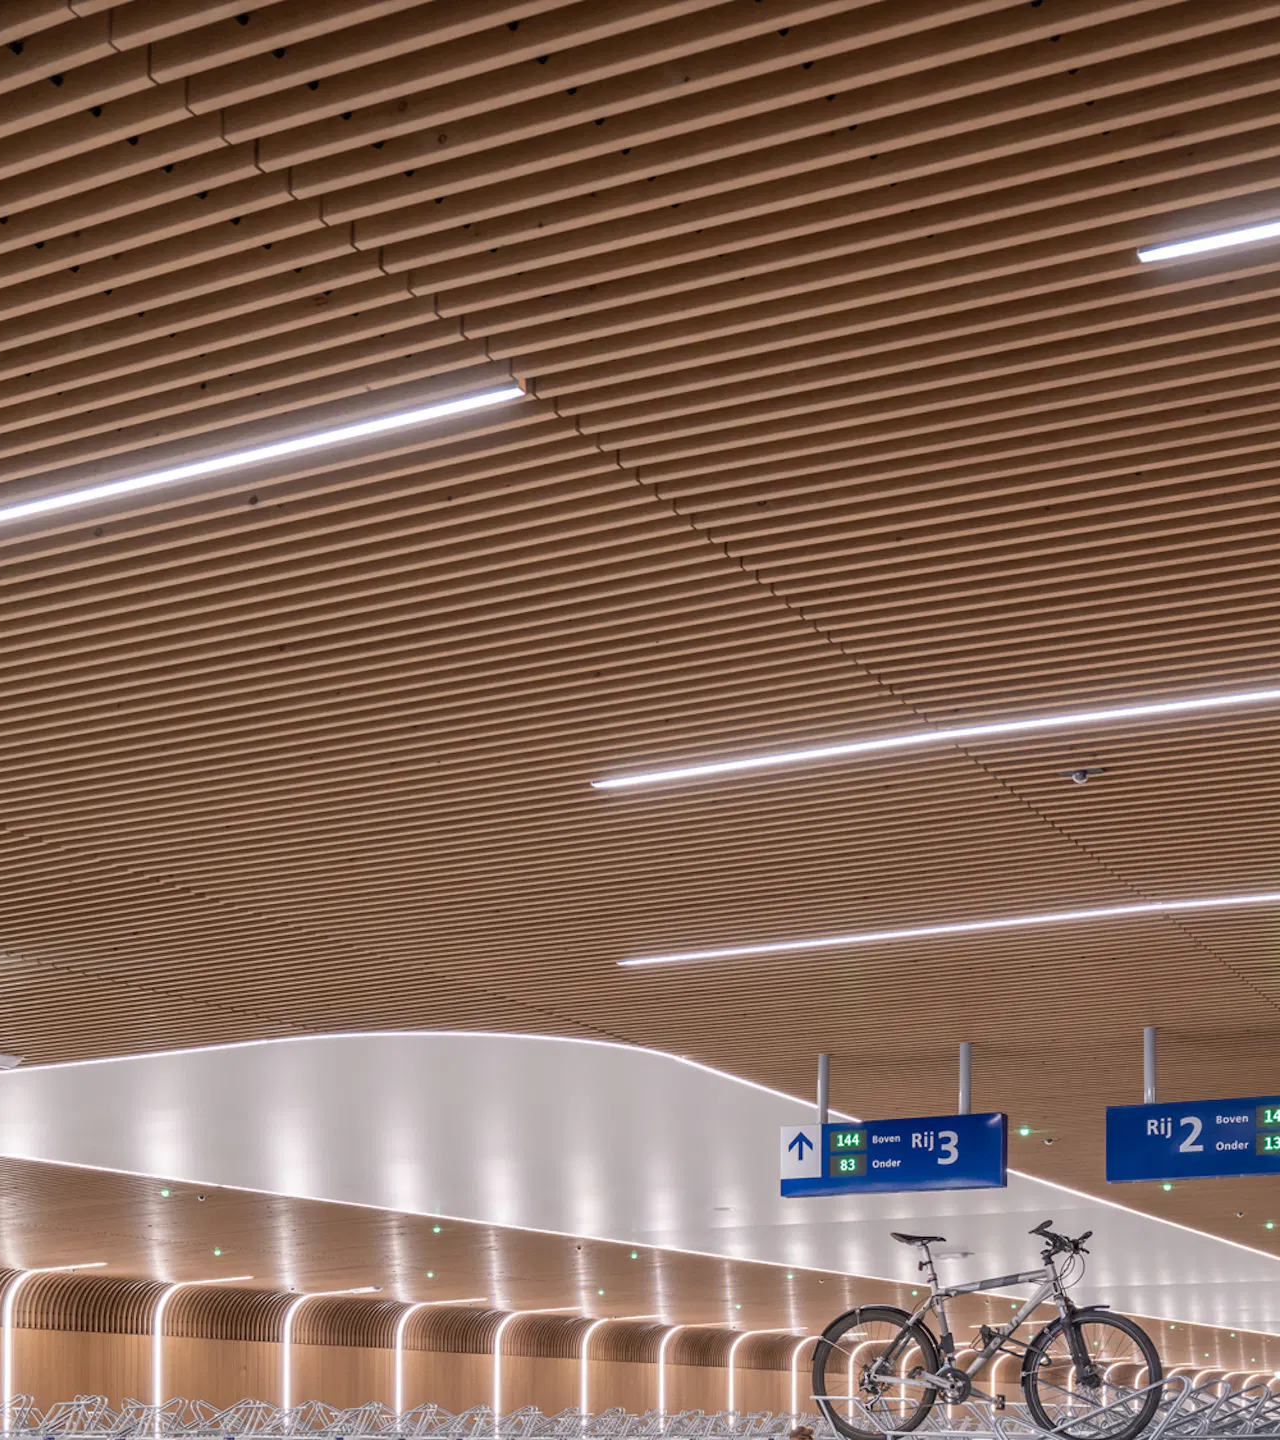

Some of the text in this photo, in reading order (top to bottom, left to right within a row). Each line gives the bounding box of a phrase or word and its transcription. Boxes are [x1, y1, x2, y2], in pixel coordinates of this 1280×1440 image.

[1215, 1114, 1249, 1125] Boven
[836, 1133, 860, 1147] 144
[872, 1134, 901, 1144] Boven
[1146, 1115, 1204, 1153] Rij 2
[911, 1130, 959, 1165] Rij 3
[1215, 1140, 1249, 1152] Onder
[839, 1158, 856, 1171] 83
[872, 1159, 902, 1169] Onder
